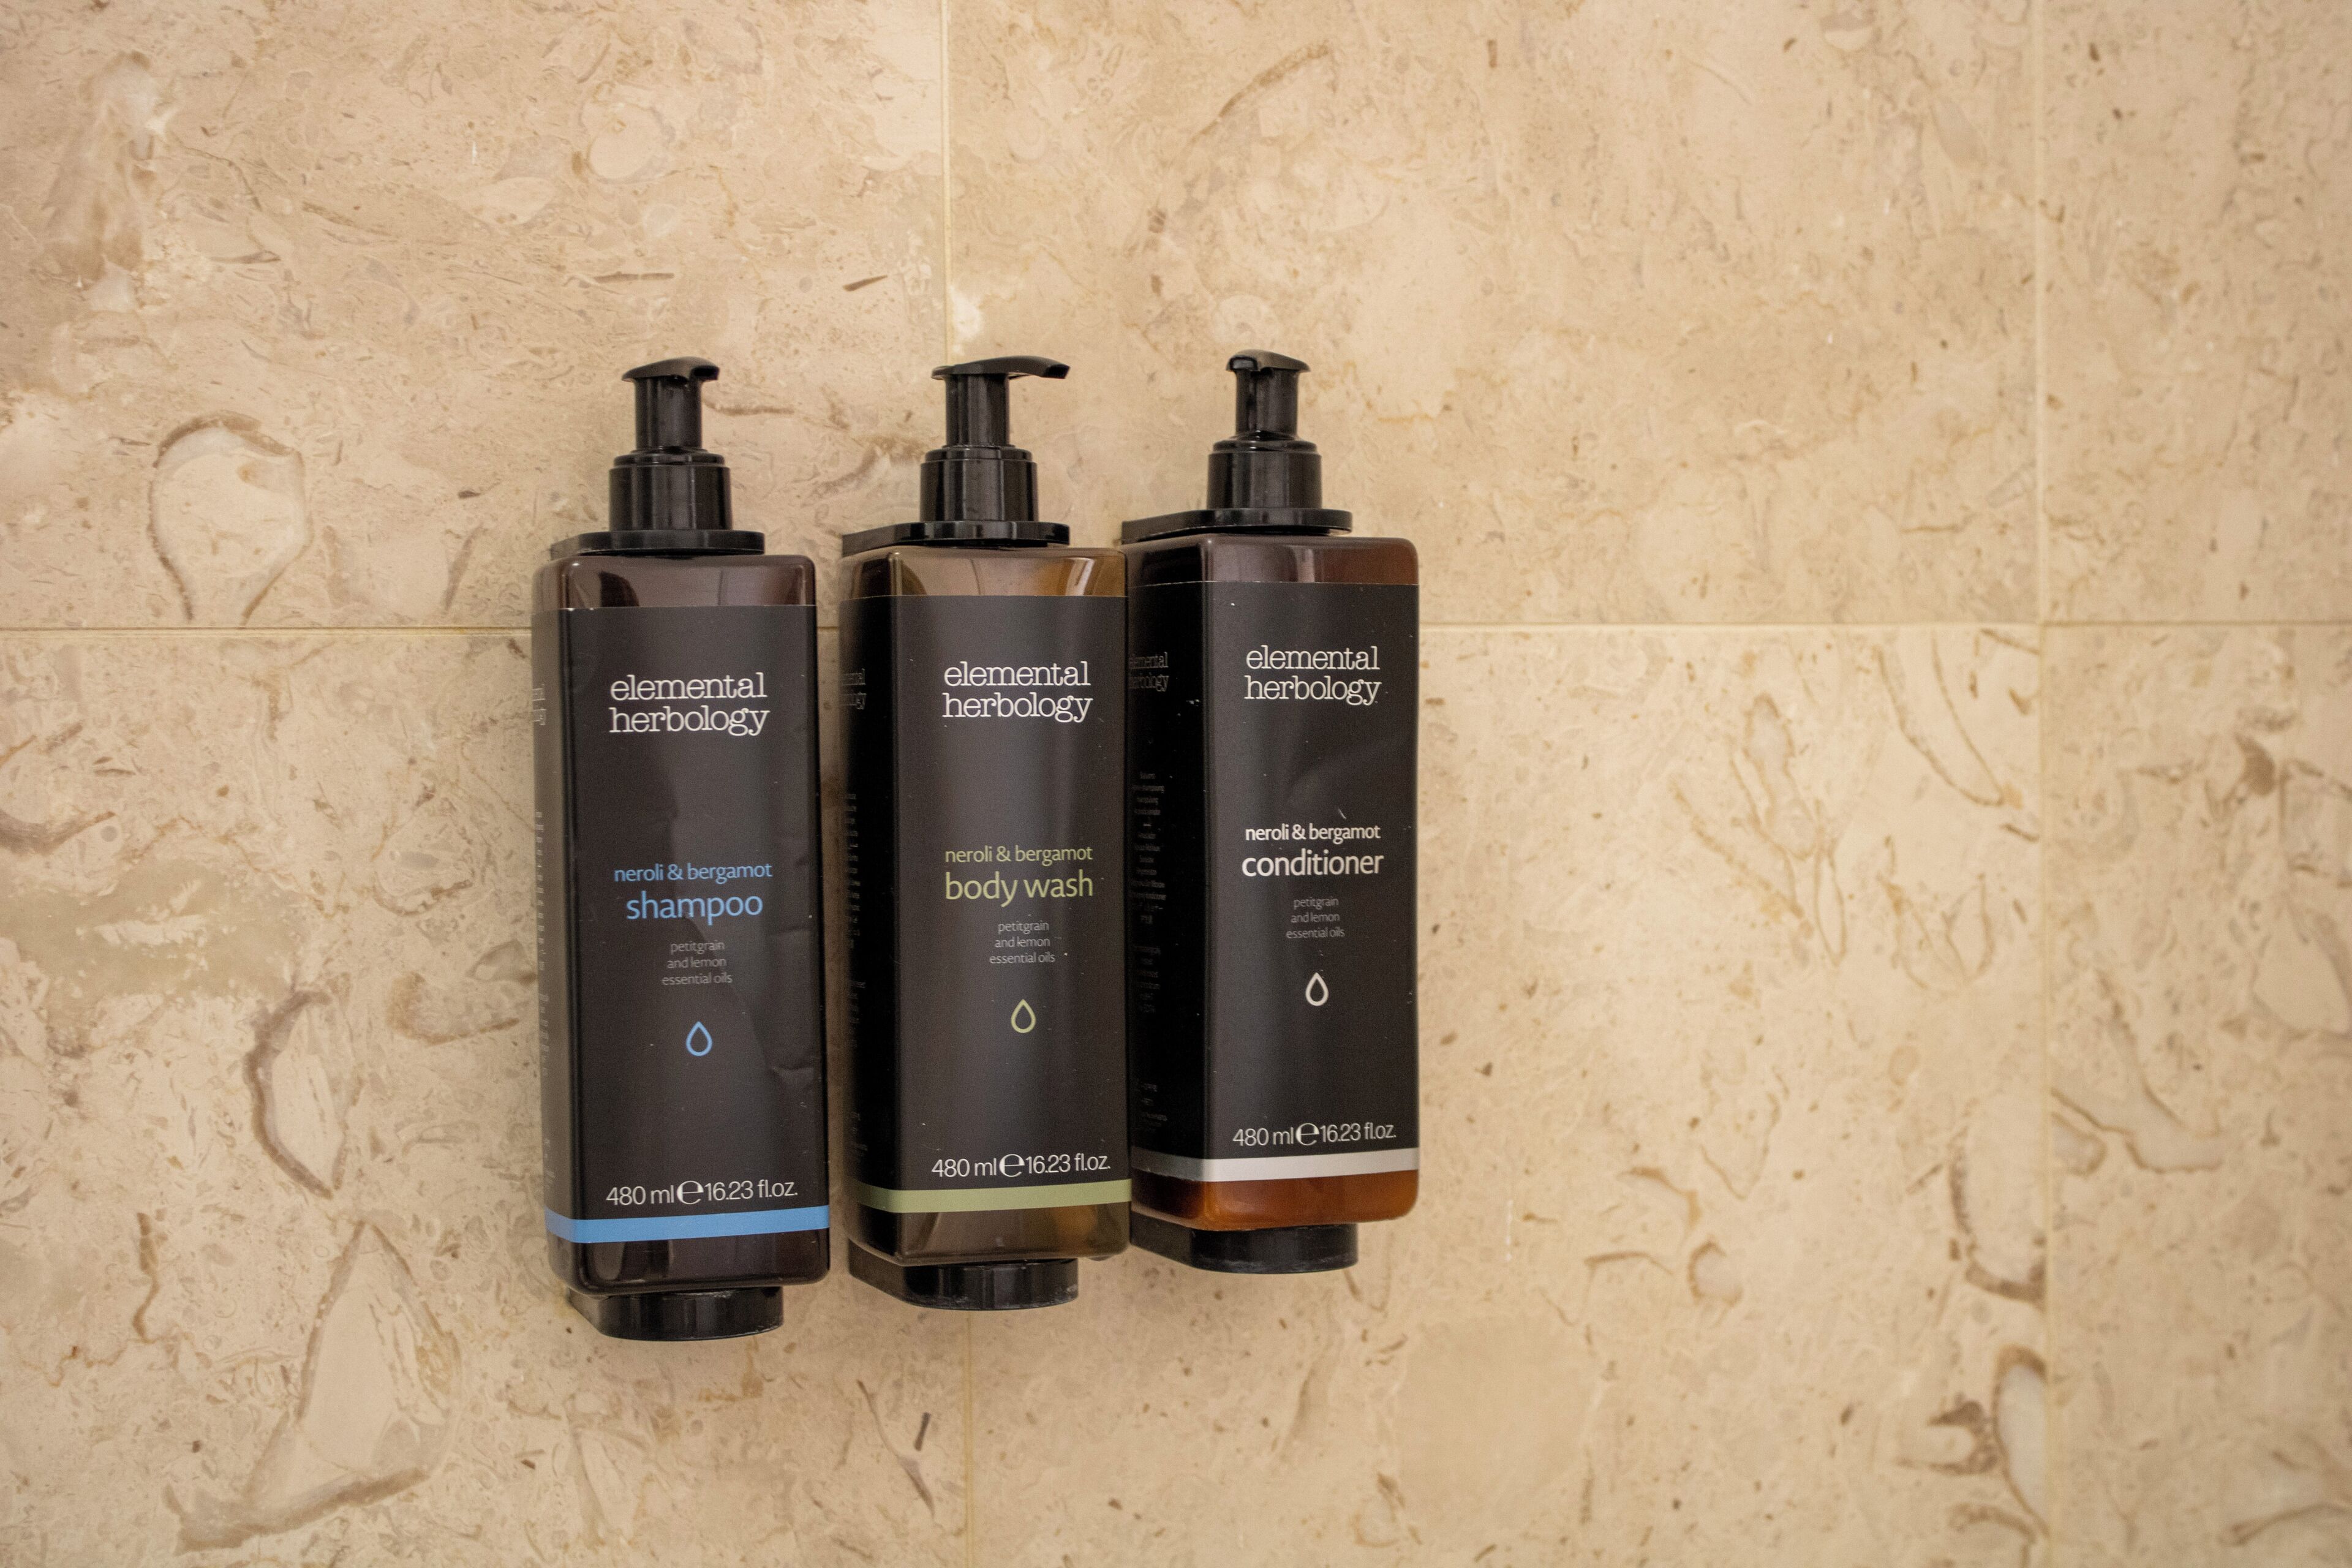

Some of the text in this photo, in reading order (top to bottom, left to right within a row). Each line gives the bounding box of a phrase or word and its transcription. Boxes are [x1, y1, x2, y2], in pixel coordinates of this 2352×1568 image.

[1246, 645, 1380, 670] elemental
[944, 661, 1091, 687] elemental
[610, 672, 767, 701] elemental
[1244, 676, 1381, 706] herbology
[943, 692, 1093, 723] herbology
[609, 706, 770, 736] herbology
[1245, 823, 1381, 845] neroli & bergamot
[945, 845, 1093, 866] neroli & bergamot
[1242, 848, 1384, 877] conditioner
[614, 863, 773, 884] neroli & bergamot
[945, 869, 1093, 907] body wash
[626, 891, 763, 925] shampoo
[1294, 897, 1338, 910] petitgrain
[998, 921, 1049, 934] petitgrain
[1291, 913, 1340, 924] and lemon
[995, 937, 1050, 948] and lemon
[1286, 927, 1345, 939] essential oils
[671, 941, 725, 955] petitgrain
[989, 951, 1055, 963] essential oils
[667, 957, 727, 968] and lemon
[662, 972, 733, 986] essential oils
[1232, 1128, 1269, 1147] 480
[1273, 1126, 1294, 1145] ml
[1321, 1123, 1360, 1142] 16.23
[931, 1159, 970, 1178] 480
[974, 1158, 997, 1177] ml
[1026, 1155, 1071, 1174] 16.23
[606, 1186, 646, 1205] 480
[650, 1185, 674, 1204] ml
[705, 1181, 753, 1201] 16.23
